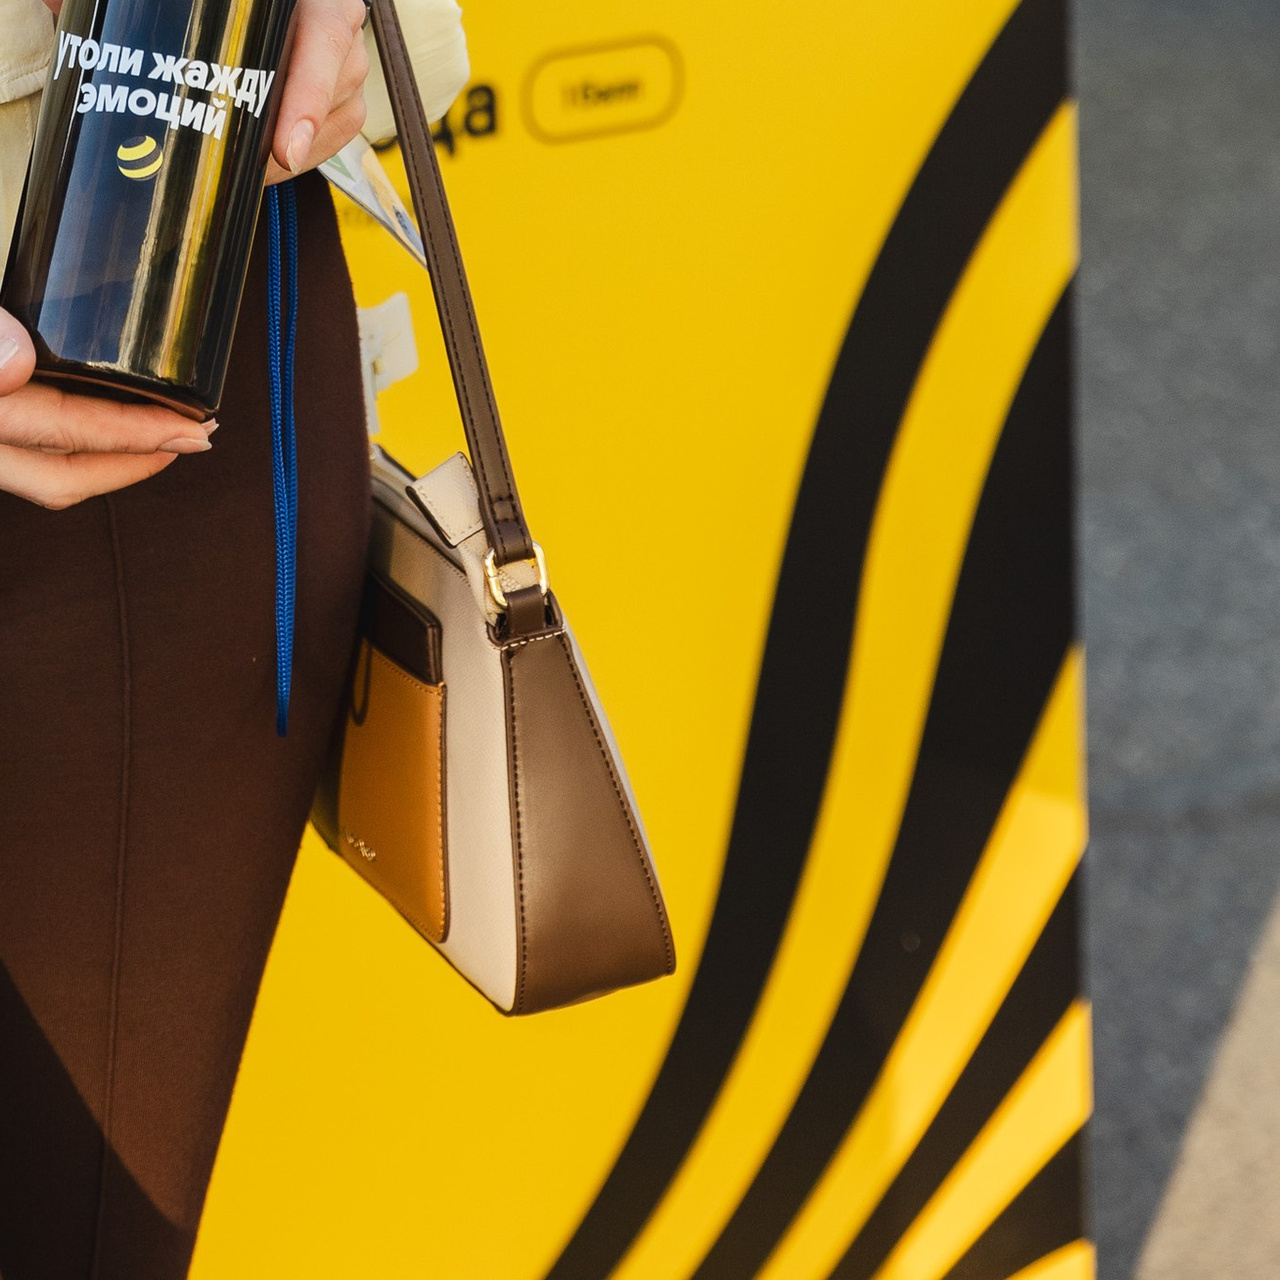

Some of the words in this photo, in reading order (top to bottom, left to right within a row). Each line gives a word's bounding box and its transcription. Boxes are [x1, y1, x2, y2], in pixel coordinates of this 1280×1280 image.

[54, 30, 144, 80] утоли
[148, 51, 276, 118] жажду
[76, 82, 227, 140] эмоций
